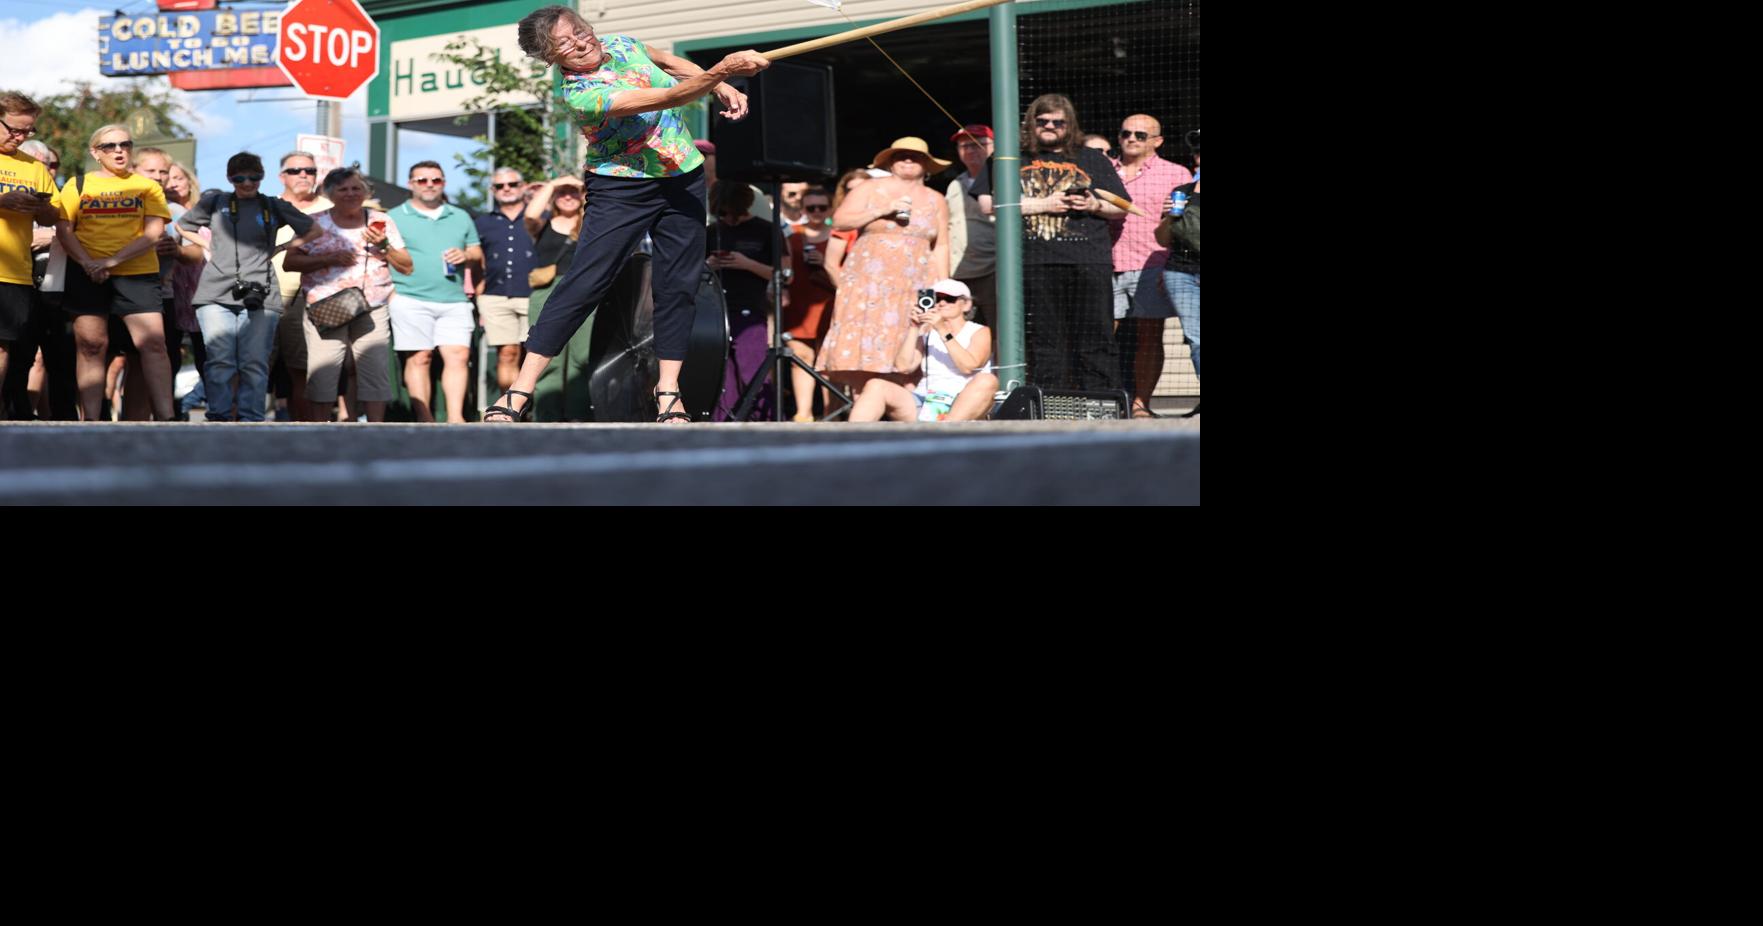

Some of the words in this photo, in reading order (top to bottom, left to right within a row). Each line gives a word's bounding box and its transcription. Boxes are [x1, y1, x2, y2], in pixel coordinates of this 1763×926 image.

[111, 15, 200, 41] COLD
[167, 38, 203, 49] TO
[285, 22, 373, 68] STOP
[112, 48, 213, 71] LUNCH
[224, 44, 278, 65] ME
[79, 197, 144, 209] PATTON
